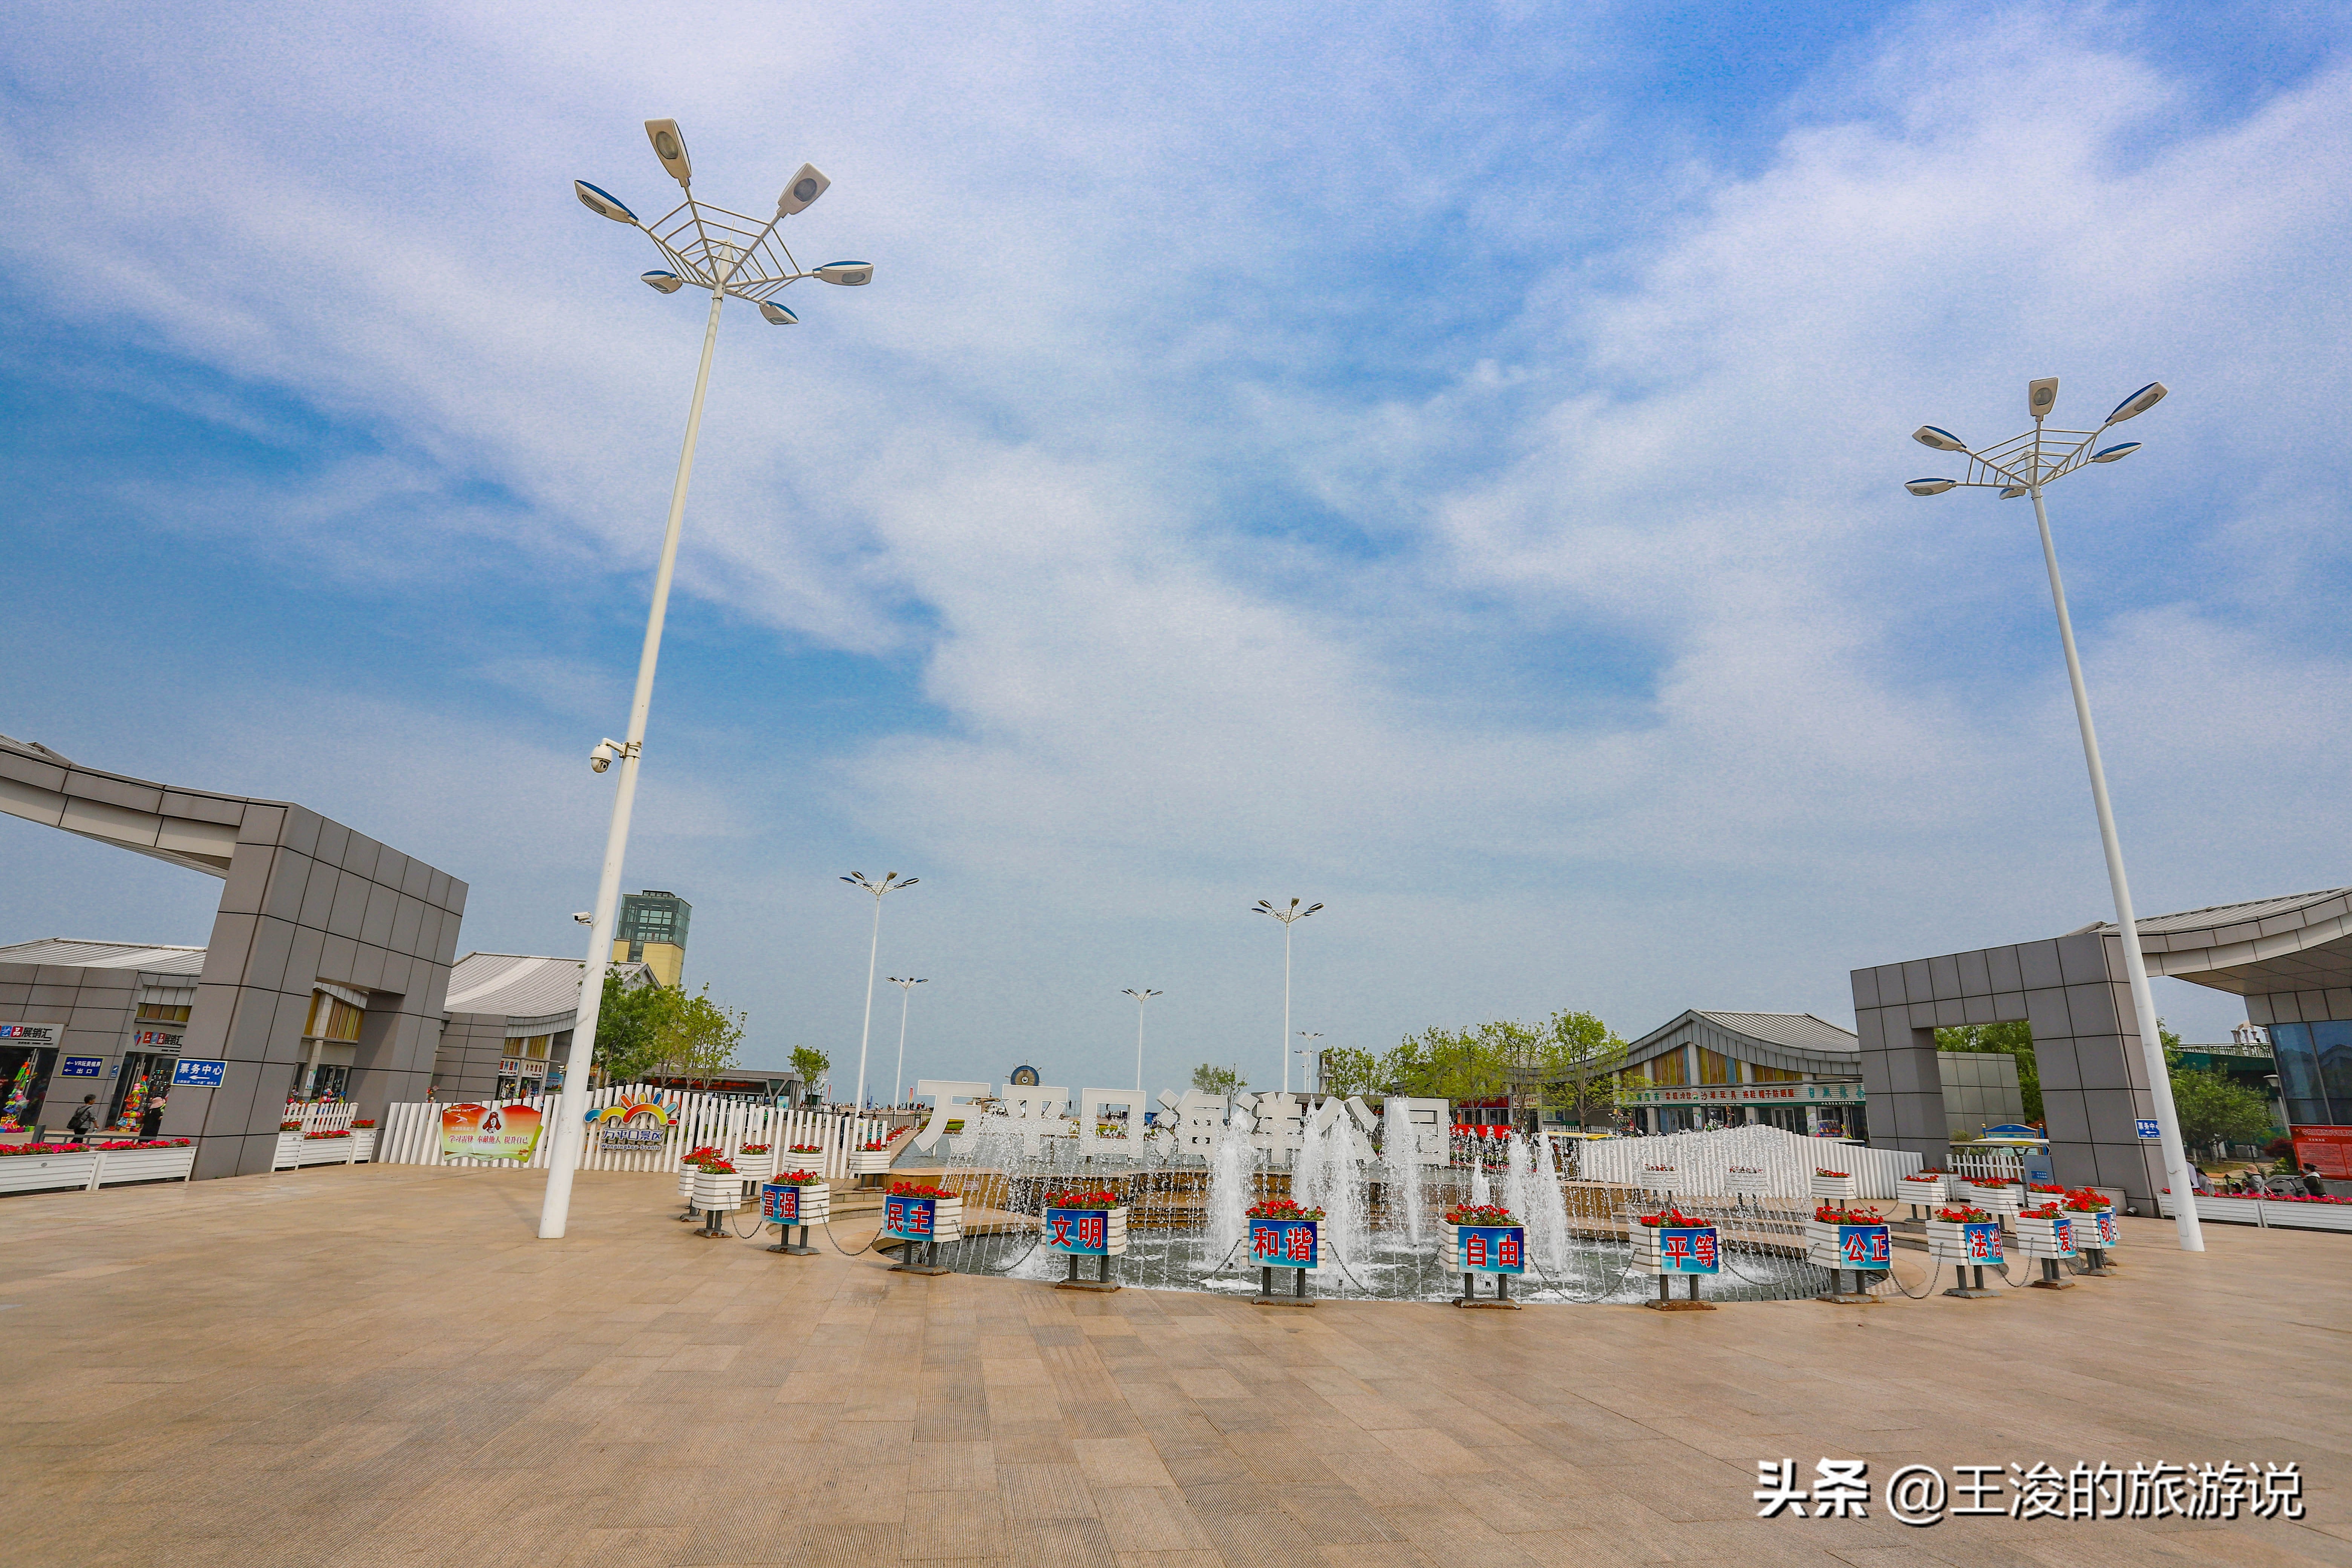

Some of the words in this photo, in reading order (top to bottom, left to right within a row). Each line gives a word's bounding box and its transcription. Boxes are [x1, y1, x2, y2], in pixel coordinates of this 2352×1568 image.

[179, 1063, 222, 1075] 票务中心
[1701, 1090, 1736, 1100] 沙滩玩具
[602, 1128, 664, 1141] 万平口景区
[914, 1080, 1450, 1166] 万平口海洋公园
[449, 1135, 474, 1143] 学习雷锋
[504, 1136, 528, 1144] 提升自己
[763, 1189, 797, 1219] 富强
[887, 1203, 930, 1234] 民主
[1050, 1215, 1103, 1249] 文明
[1253, 1226, 1314, 1262] 和谐
[1844, 1232, 1888, 1263] 公正
[1969, 1228, 2003, 1259] 法治
[1466, 1234, 1519, 1267] 自由
[1665, 1234, 1717, 1268] 平等
